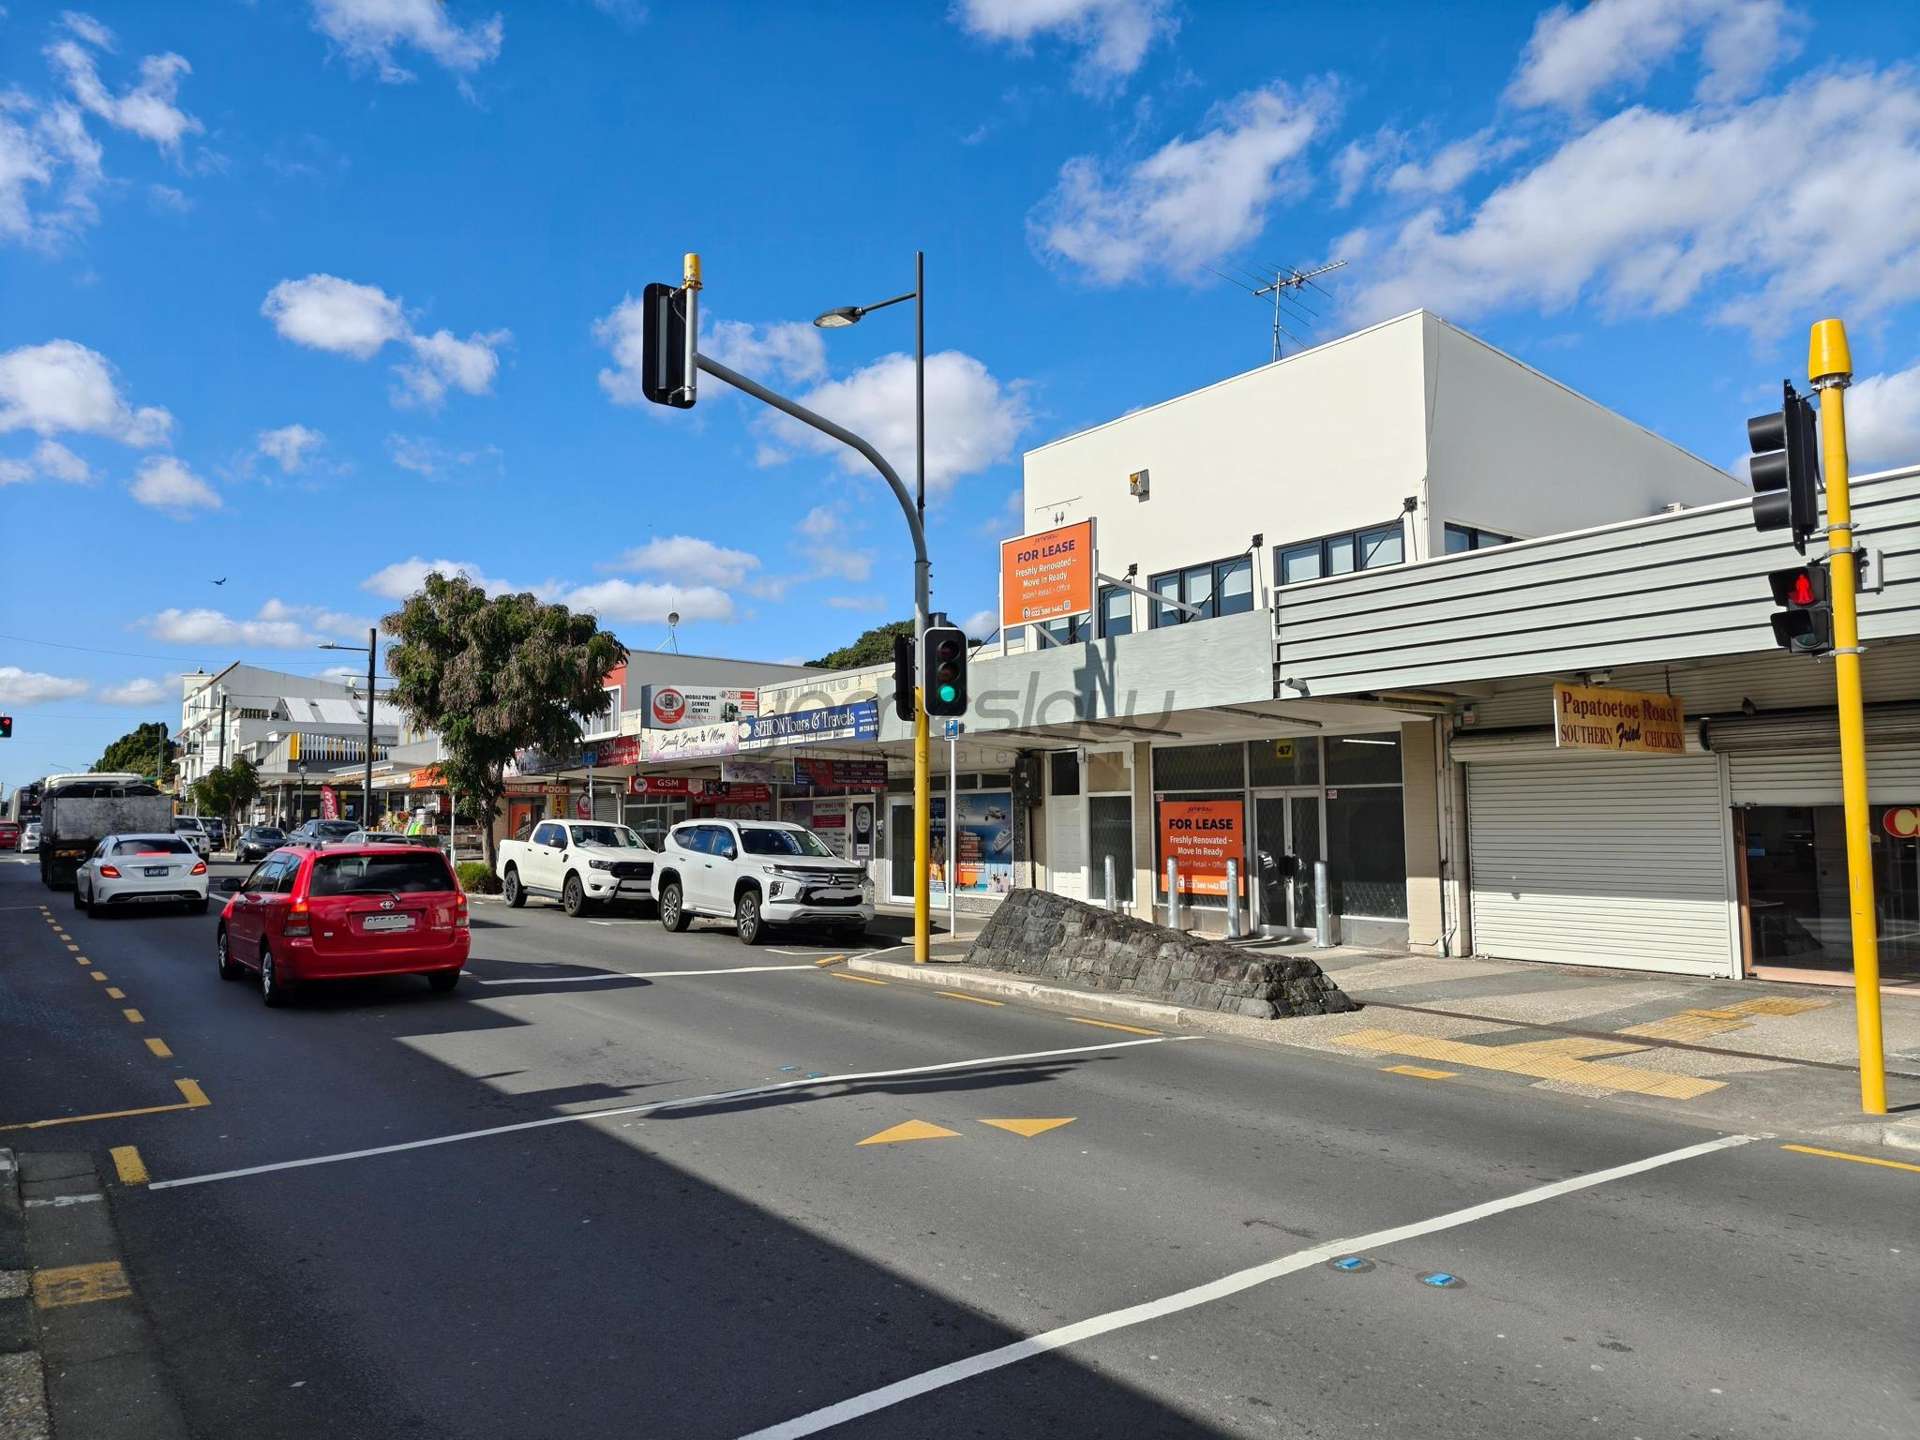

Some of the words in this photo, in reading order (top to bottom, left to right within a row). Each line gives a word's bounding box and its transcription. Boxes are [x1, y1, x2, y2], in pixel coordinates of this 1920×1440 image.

[1017, 549, 1039, 564] FOR
[1042, 540, 1076, 557] LEASE
[1015, 565, 1037, 578] Freshly
[1039, 558, 1072, 573] Renovated
[1023, 577, 1040, 587] Move
[1048, 572, 1068, 583] Ready
[1561, 691, 1638, 719] Papatoetoe
[1642, 699, 1678, 722] Roast
[785, 716, 810, 733] Tours
[811, 712, 820, 729] &
[820, 707, 855, 729] Travels
[1560, 724, 1613, 745] SOUTHERN
[1644, 730, 1682, 749] CHICKEN
[1278, 745, 1291, 755] 47
[657, 779, 679, 788] GSM
[1169, 818, 1192, 830] FOR
[1196, 818, 1233, 830] LEASE
[1169, 836, 1193, 845] Freshly
[1193, 836, 1227, 845] Renovated
[1178, 847, 1195, 855] Move
[1203, 848, 1223, 857] Ready
